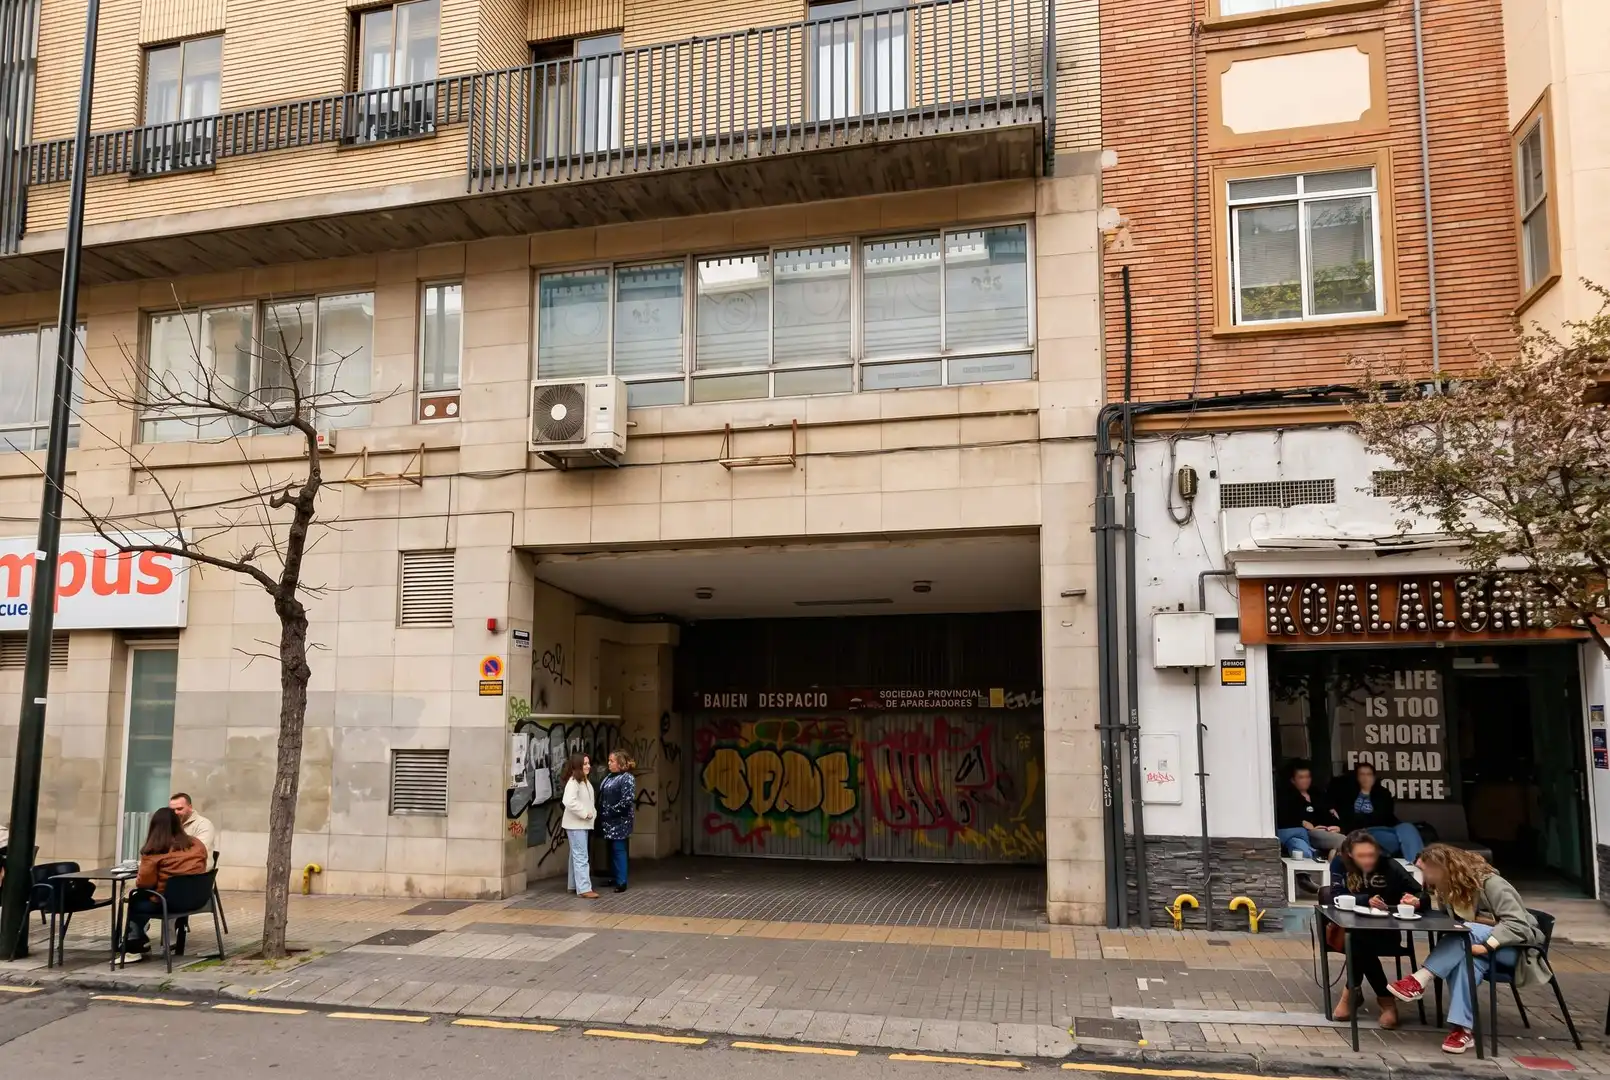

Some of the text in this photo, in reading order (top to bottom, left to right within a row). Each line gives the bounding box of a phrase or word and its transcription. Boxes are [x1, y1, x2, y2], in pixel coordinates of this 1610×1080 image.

[1394, 669, 1437, 690] LIFE
[704, 692, 828, 708] BAUEN DESPACIO
[879, 689, 983, 699] SOCIEDAD PROVINCIAL
[885, 699, 898, 708] DE
[900, 699, 973, 708] APAREJADORES
[1365, 697, 1439, 717] IS TOO
[1364, 724, 1440, 744] SHORT
[1395, 751, 1442, 772] BAD
[1380, 778, 1445, 800] OFFEE
